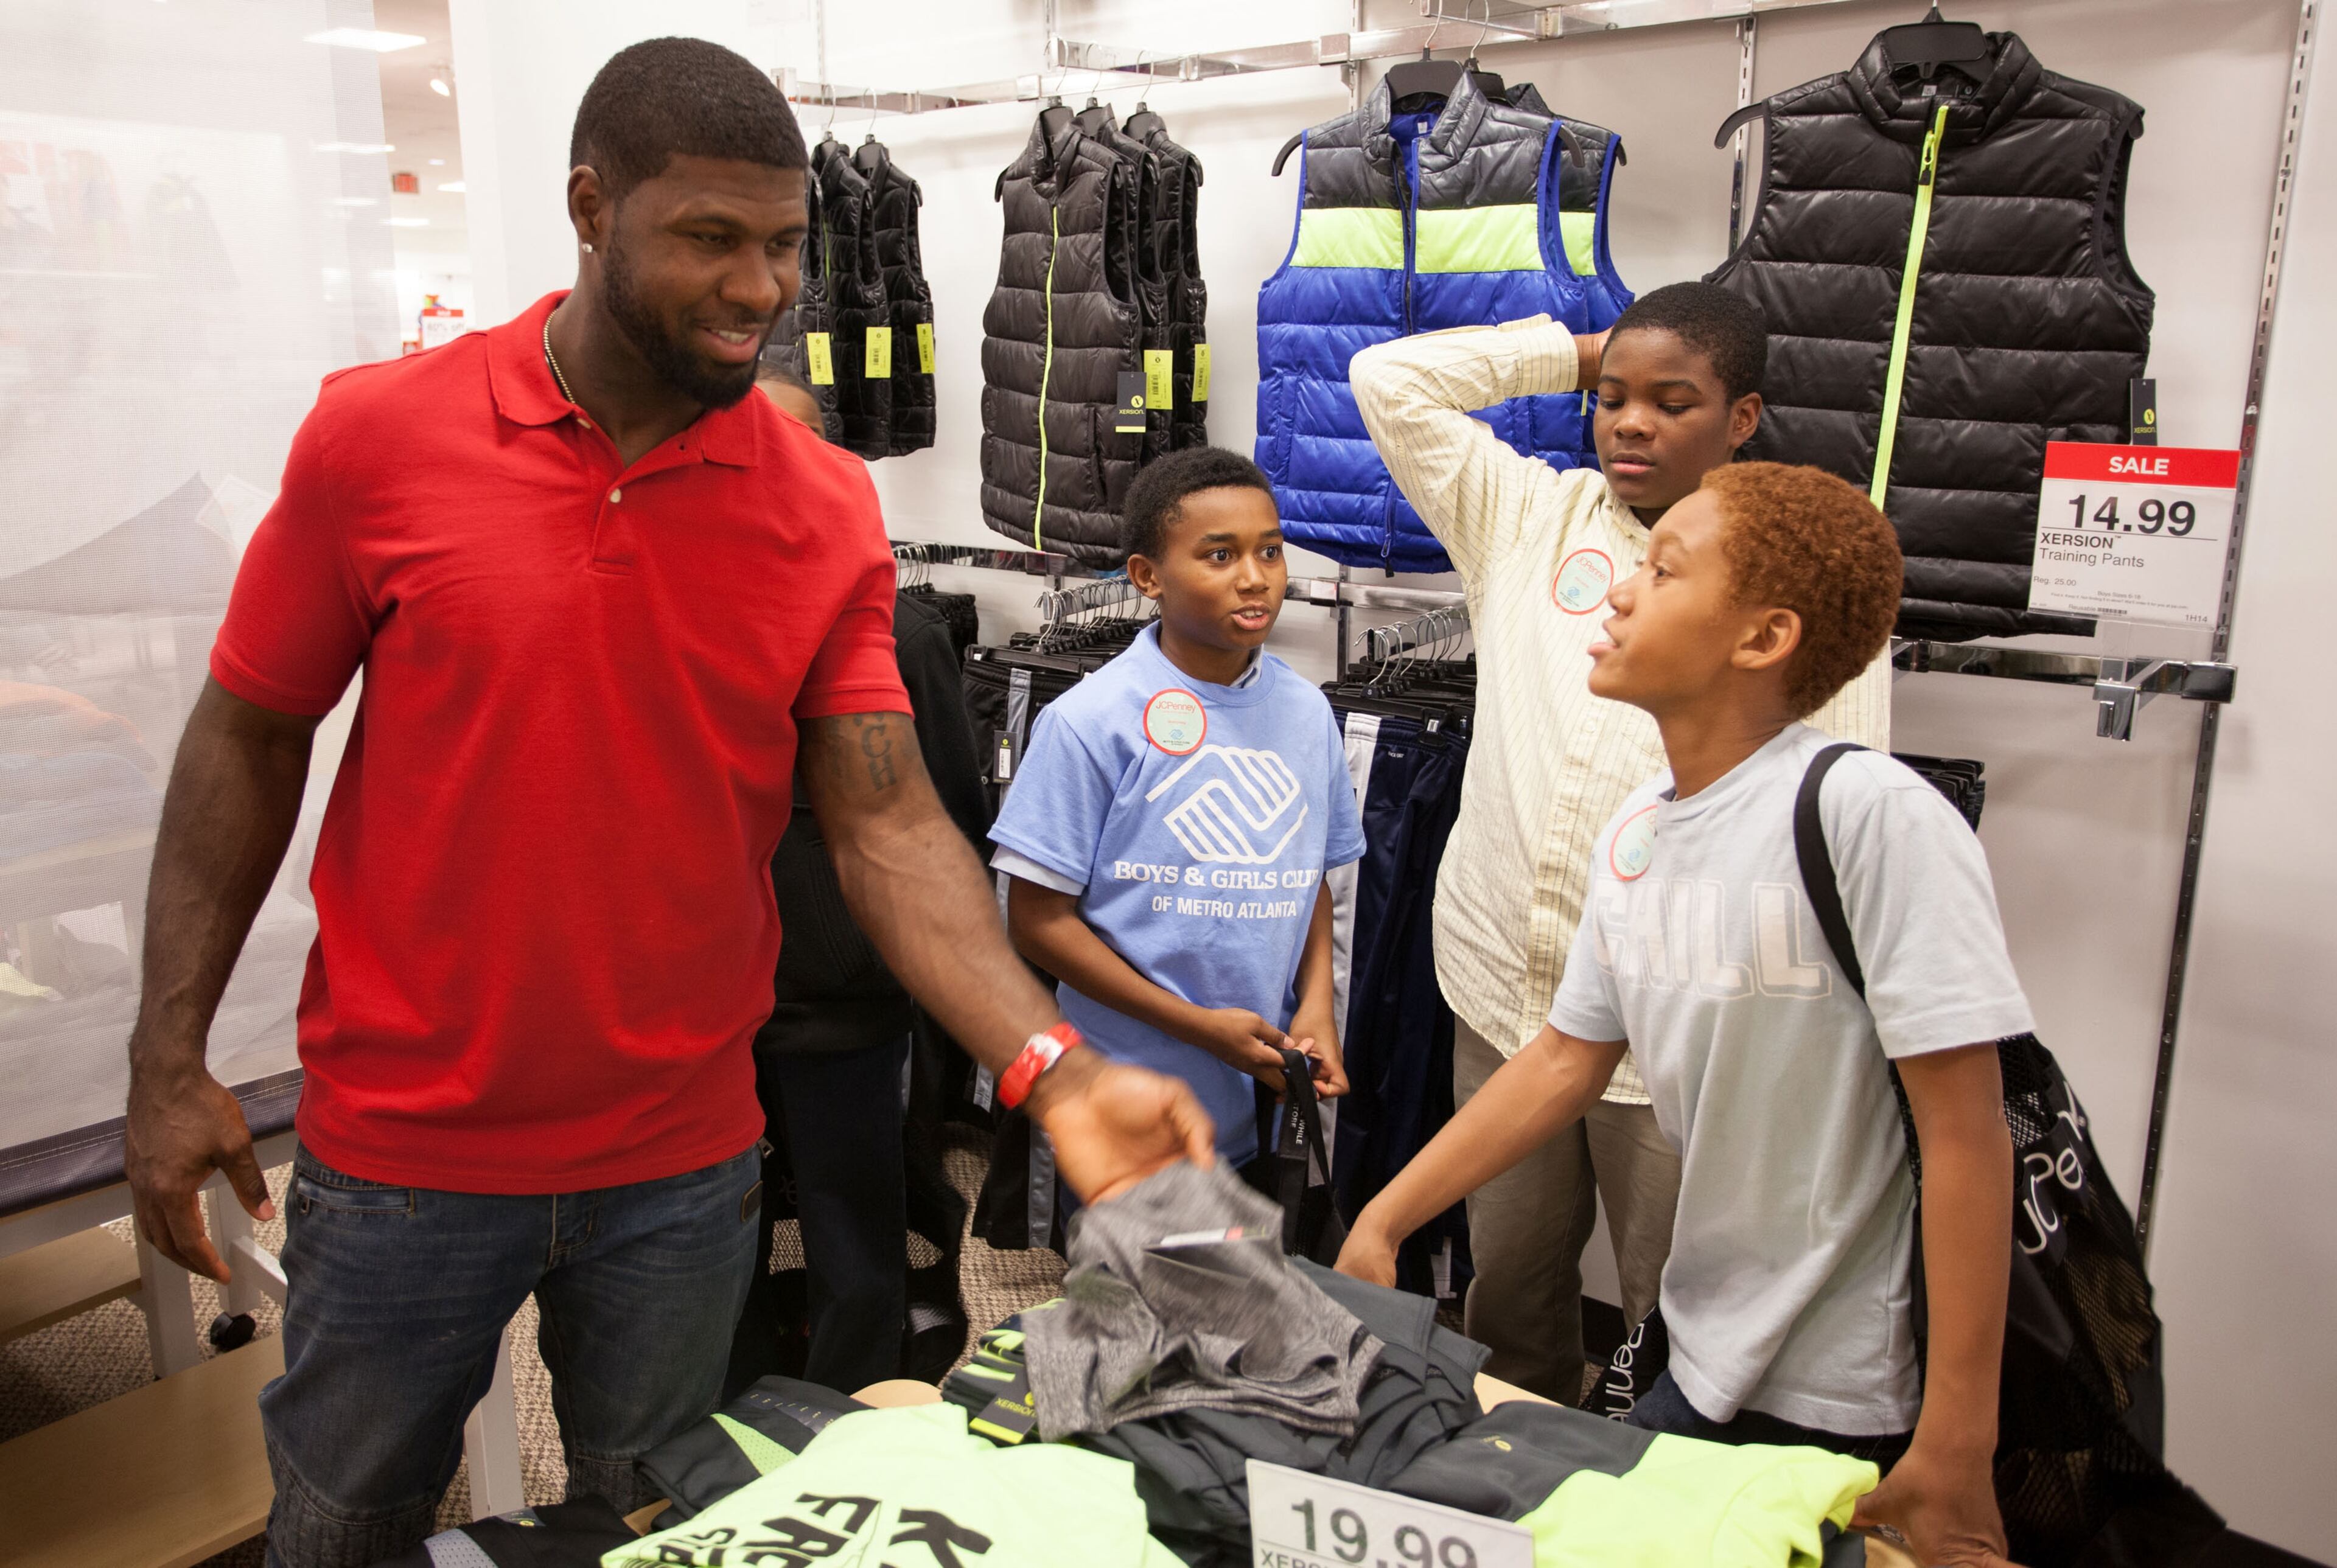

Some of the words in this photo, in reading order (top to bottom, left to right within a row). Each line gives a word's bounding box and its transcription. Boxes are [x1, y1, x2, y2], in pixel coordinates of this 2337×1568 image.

[2108, 456, 2170, 475] SALE
[2069, 494, 2196, 536] 14.99
[2039, 548, 2097, 566] Training
[2102, 553, 2145, 568] Pants
[2033, 576, 2050, 585] Reg.
[1156, 700, 1196, 714] JCPenney
[1114, 860, 1179, 884] BOYS
[1184, 866, 1206, 887] &
[1211, 870, 1277, 889] GIRLS
[1152, 895, 1172, 912] OF
[1178, 897, 1234, 918] METRO
[1237, 901, 1297, 919] ATLANTA
[1291, 1498, 1478, 1568] 19.99
